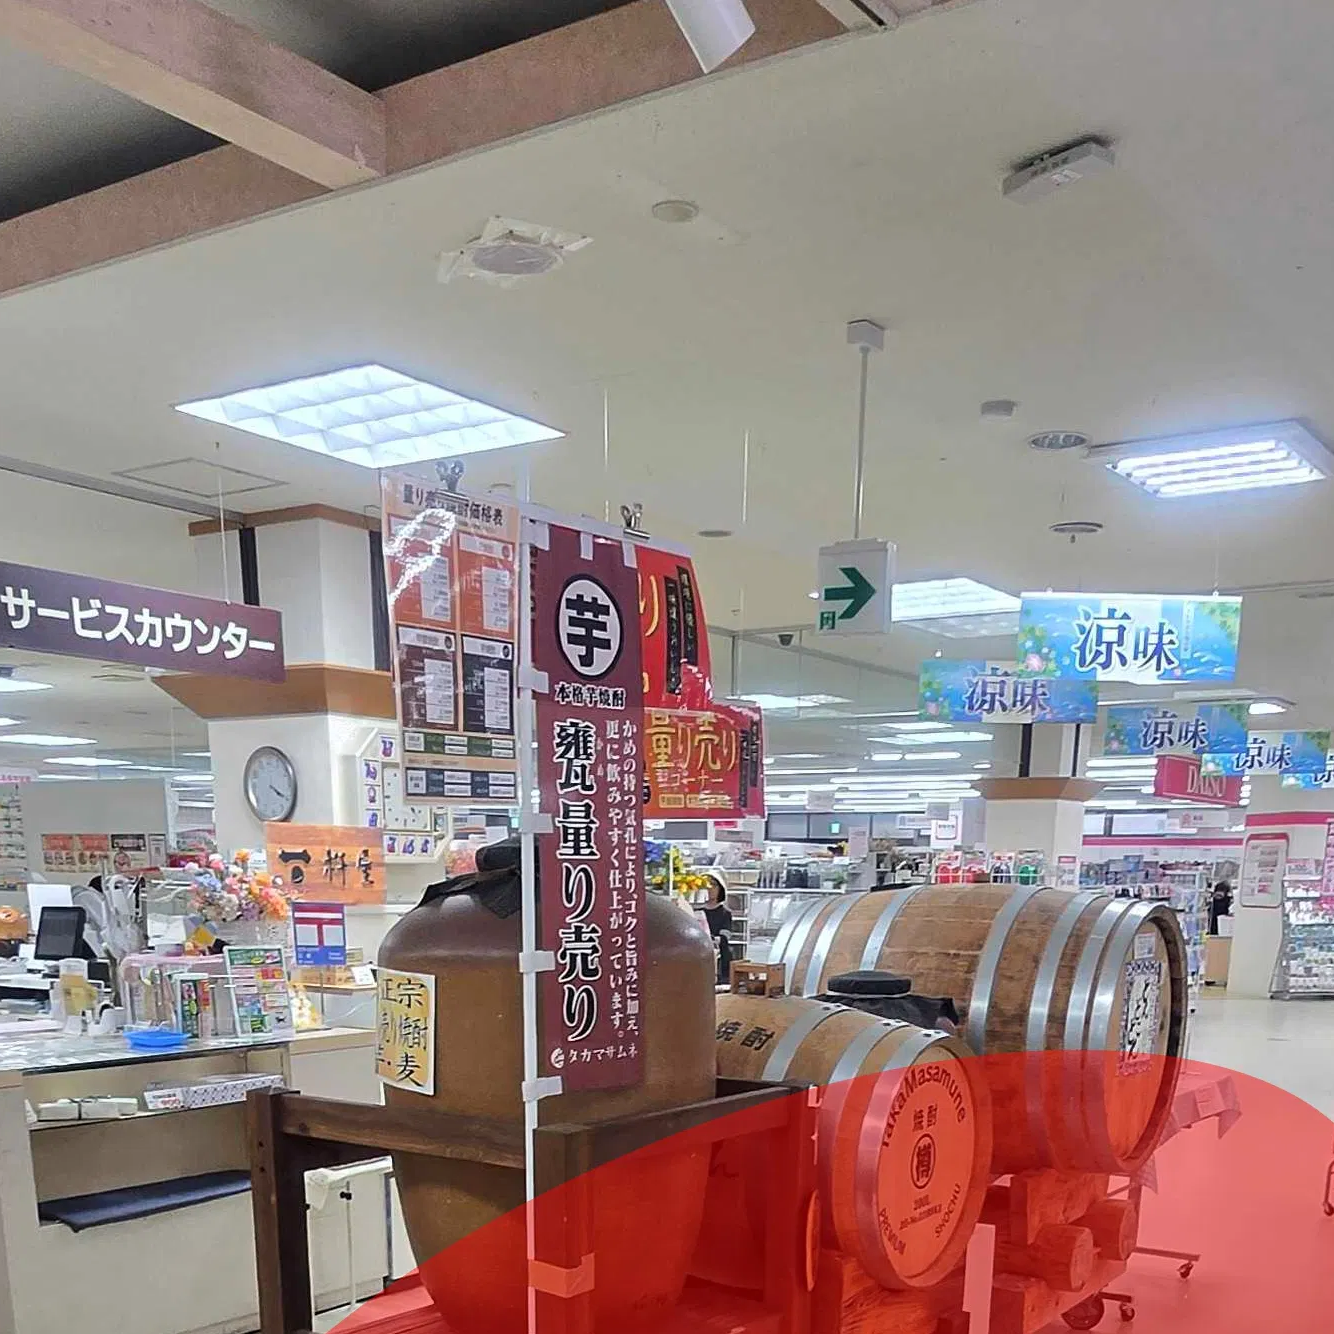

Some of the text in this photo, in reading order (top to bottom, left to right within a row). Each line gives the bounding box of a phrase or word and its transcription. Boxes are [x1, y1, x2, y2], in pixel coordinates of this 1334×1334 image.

[0, 586, 276, 660] サービスカウンター
[565, 594, 612, 668] 芋
[1075, 605, 1179, 673] 涼味
[554, 682, 627, 710] 本格芋焼酎
[965, 666, 1051, 715] 涼味
[645, 710, 736, 771] 量り売り
[1141, 710, 1209, 750] 涼味
[1234, 737, 1292, 770] 涼味
[1186, 765, 1227, 797] DAISO
[568, 1043, 639, 1064] タカマサムネ
